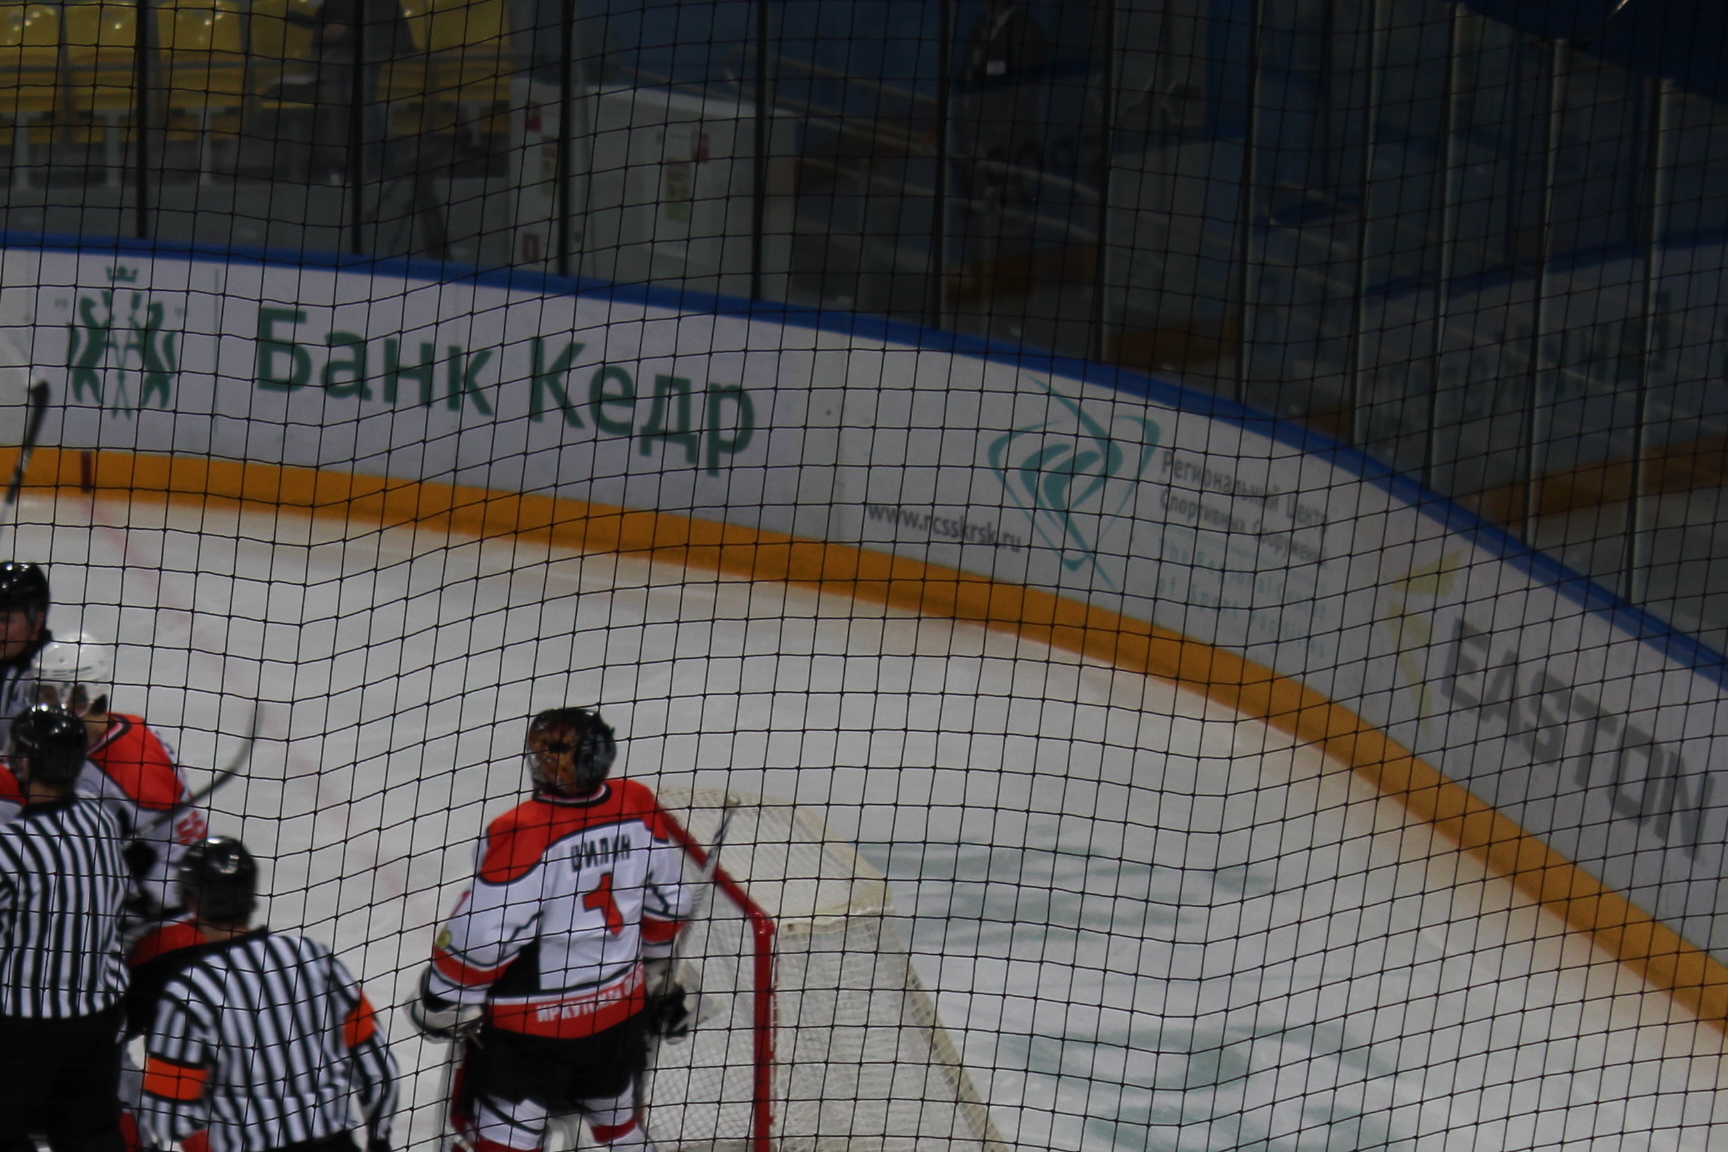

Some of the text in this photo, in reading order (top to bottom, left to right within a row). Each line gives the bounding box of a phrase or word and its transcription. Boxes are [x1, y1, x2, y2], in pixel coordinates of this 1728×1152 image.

[256, 307, 754, 477] Банк Кедр
[1440, 617, 1715, 862] EASTON
[582, 872, 624, 937] 1
